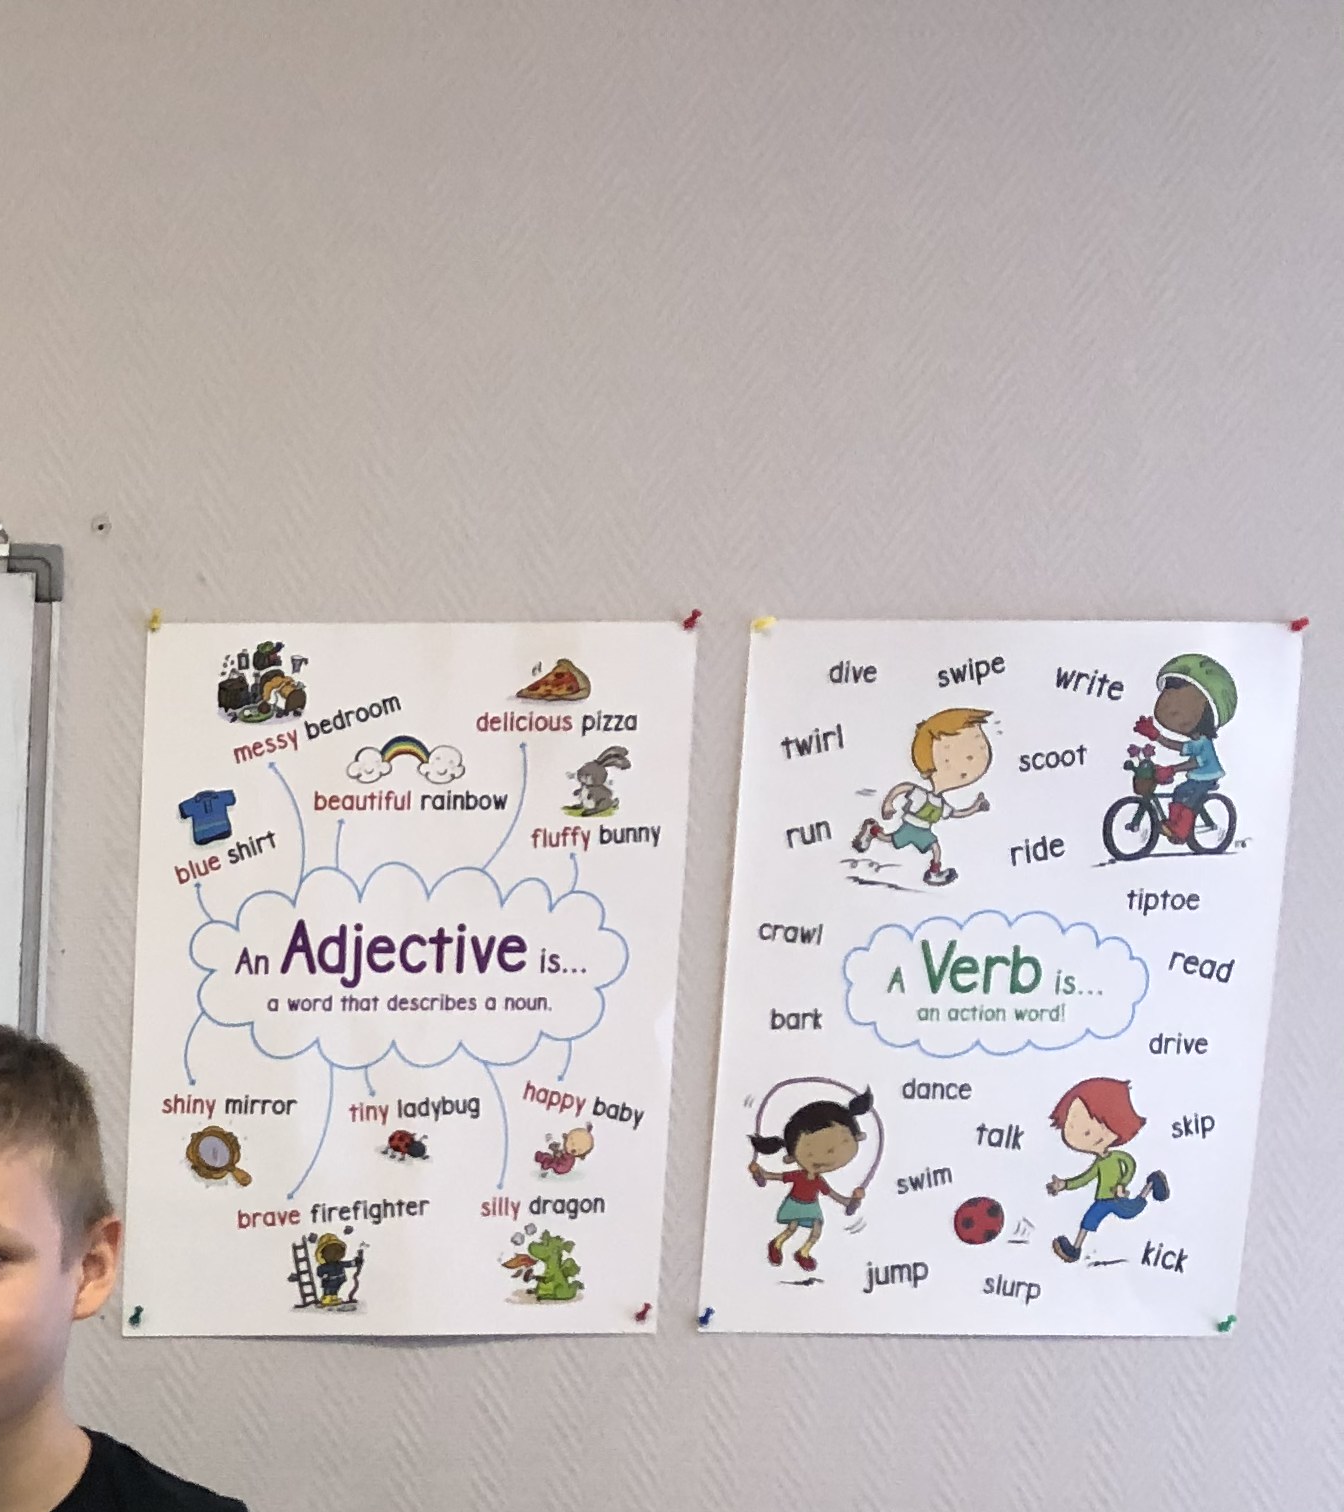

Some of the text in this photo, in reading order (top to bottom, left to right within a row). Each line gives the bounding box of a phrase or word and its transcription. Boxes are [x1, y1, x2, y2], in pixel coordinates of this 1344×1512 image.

[829, 662, 878, 685] dive
[937, 653, 1006, 690] swipe
[1055, 666, 1125, 702] write
[233, 694, 402, 765] messy bedroom
[476, 710, 637, 737] delicious pizza
[781, 725, 845, 760] twirl
[1019, 745, 1088, 772] scoot
[314, 790, 508, 812] beautiful rainbow
[531, 822, 661, 851] fluffy bunny
[786, 818, 833, 850] run
[174, 829, 277, 886] blue shirt
[1009, 835, 1066, 867] ride
[1127, 889, 1201, 915] tiptoe
[758, 921, 823, 946] crawl
[235, 919, 587, 989] An Adjective is...
[887, 939, 1104, 995] A Verb is...
[1168, 950, 1234, 985] read
[267, 993, 552, 1012] a word that describes a noun.
[917, 1004, 1067, 1023] an action word!
[771, 1008, 823, 1030] bark
[1149, 1033, 1209, 1055] drive
[523, 1081, 645, 1129] happy baby
[902, 1078, 972, 1102] dance
[162, 1093, 298, 1119] shiny mirror
[348, 1096, 481, 1126] tiny ladybug
[976, 1123, 1026, 1152] talk
[1171, 1113, 1216, 1139] skip
[897, 1164, 954, 1196] swim
[237, 1196, 430, 1230] brave firefighter
[481, 1195, 605, 1222] silly dragon
[1140, 1240, 1190, 1273] kick
[863, 1259, 930, 1294] jump
[982, 1273, 1042, 1304] slurp
